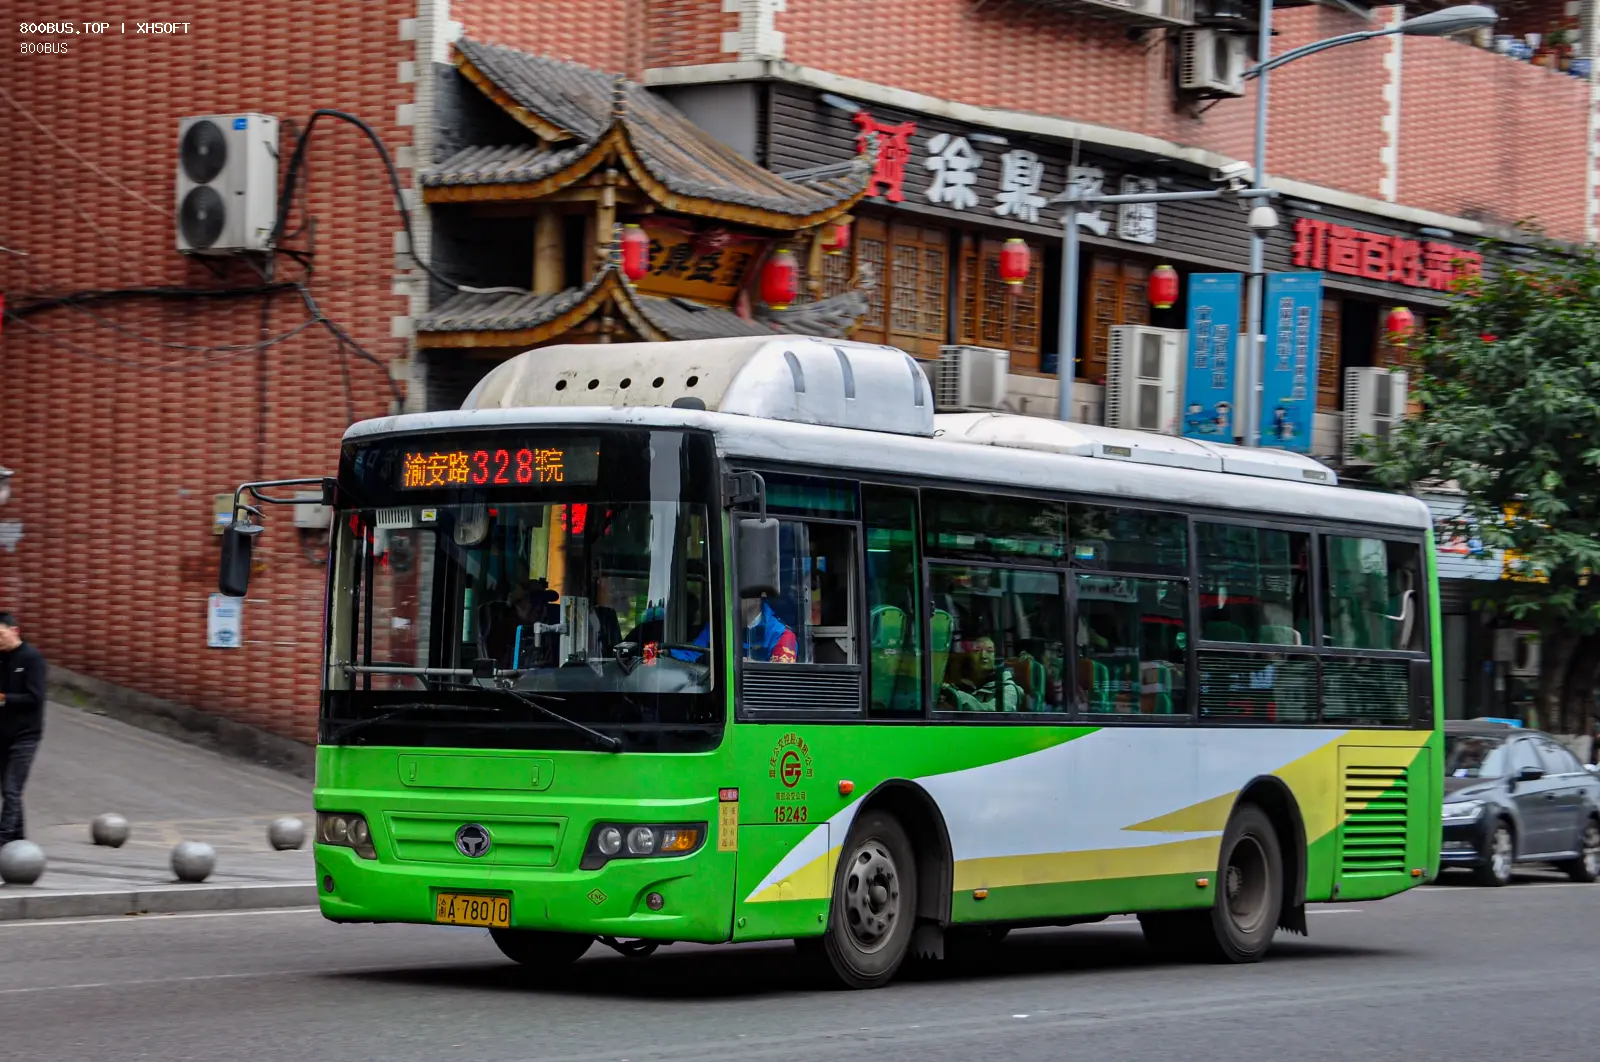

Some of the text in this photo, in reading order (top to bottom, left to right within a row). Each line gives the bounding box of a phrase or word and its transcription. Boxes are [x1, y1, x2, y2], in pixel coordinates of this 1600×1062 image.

[404, 452, 470, 487] 渝安路
[472, 449, 533, 485] 328
[774, 805, 808, 823] 15243
